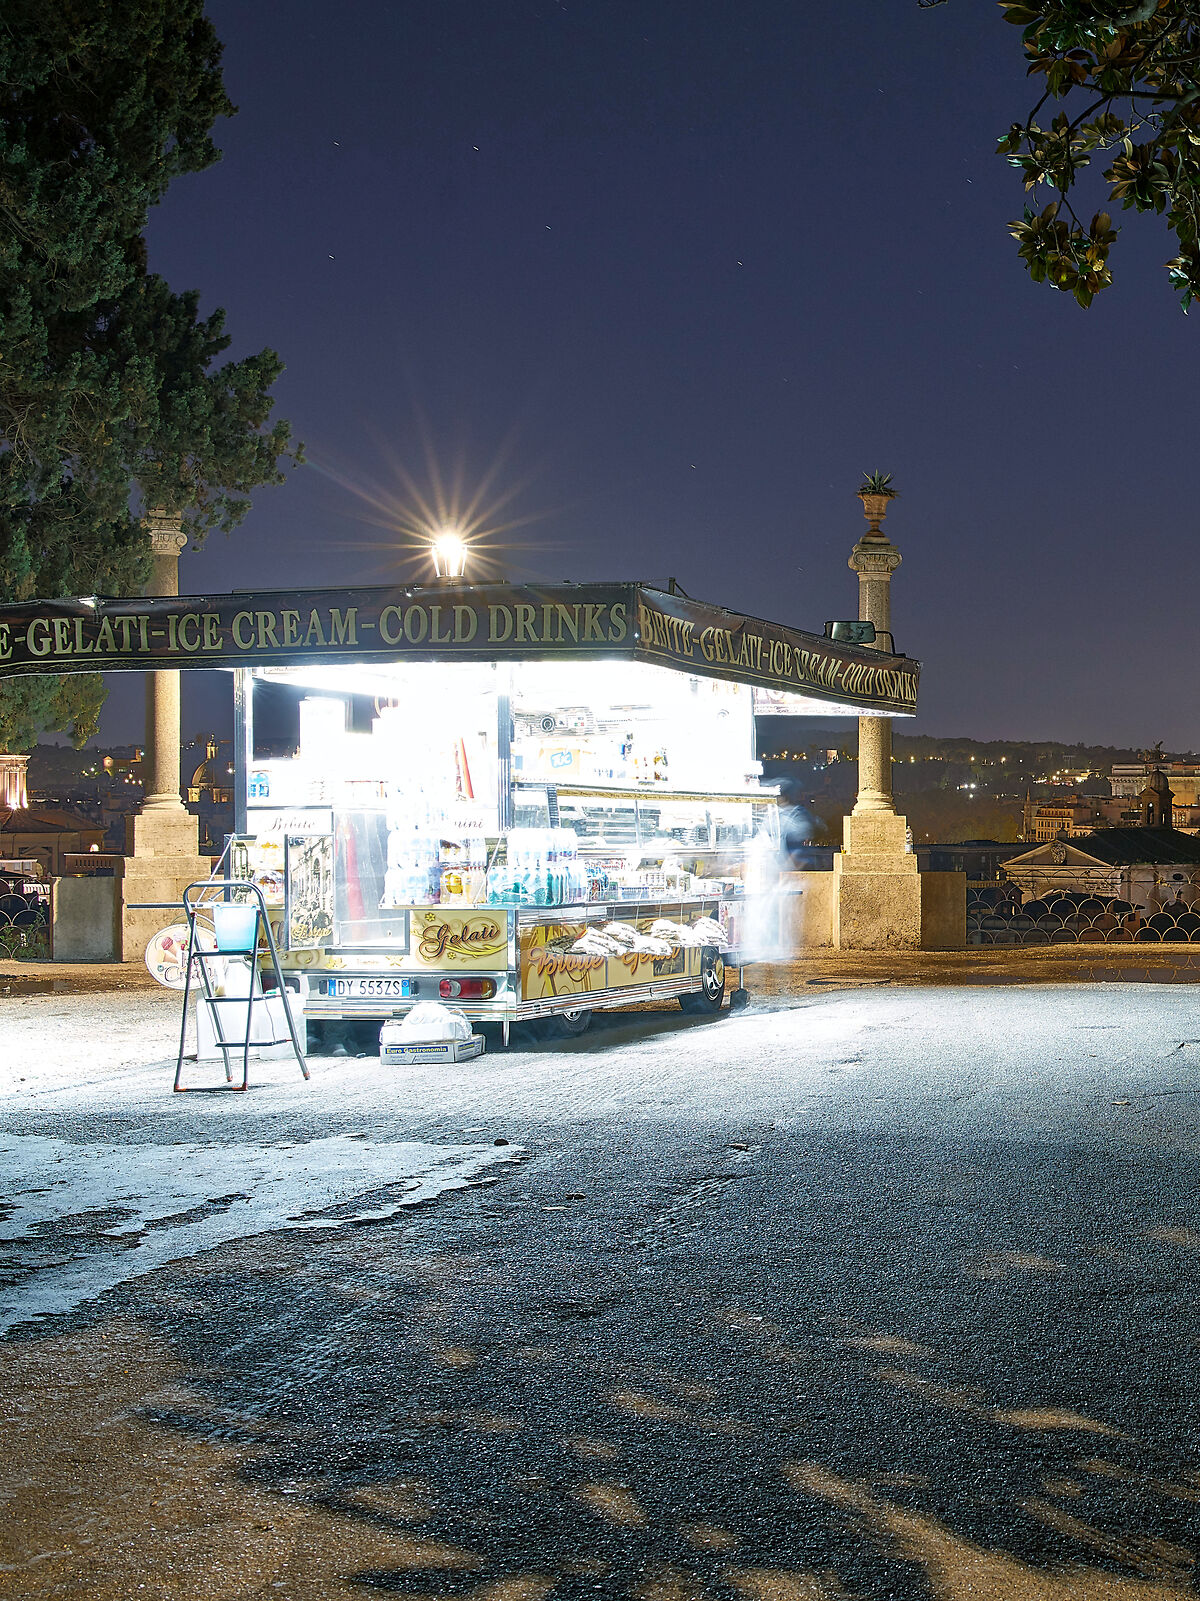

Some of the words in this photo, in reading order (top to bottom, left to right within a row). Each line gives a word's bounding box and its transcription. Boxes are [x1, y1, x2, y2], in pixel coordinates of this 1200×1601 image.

[487, 602, 628, 643] DRINKS
[874, 668, 919, 703] DRINKS
[453, 817, 485, 829] nini
[418, 923, 501, 959] Gelati
[338, 980, 354, 996] DY
[386, 1047, 403, 1055] Euro
[403, 1045, 447, 1055] Gastronomia
